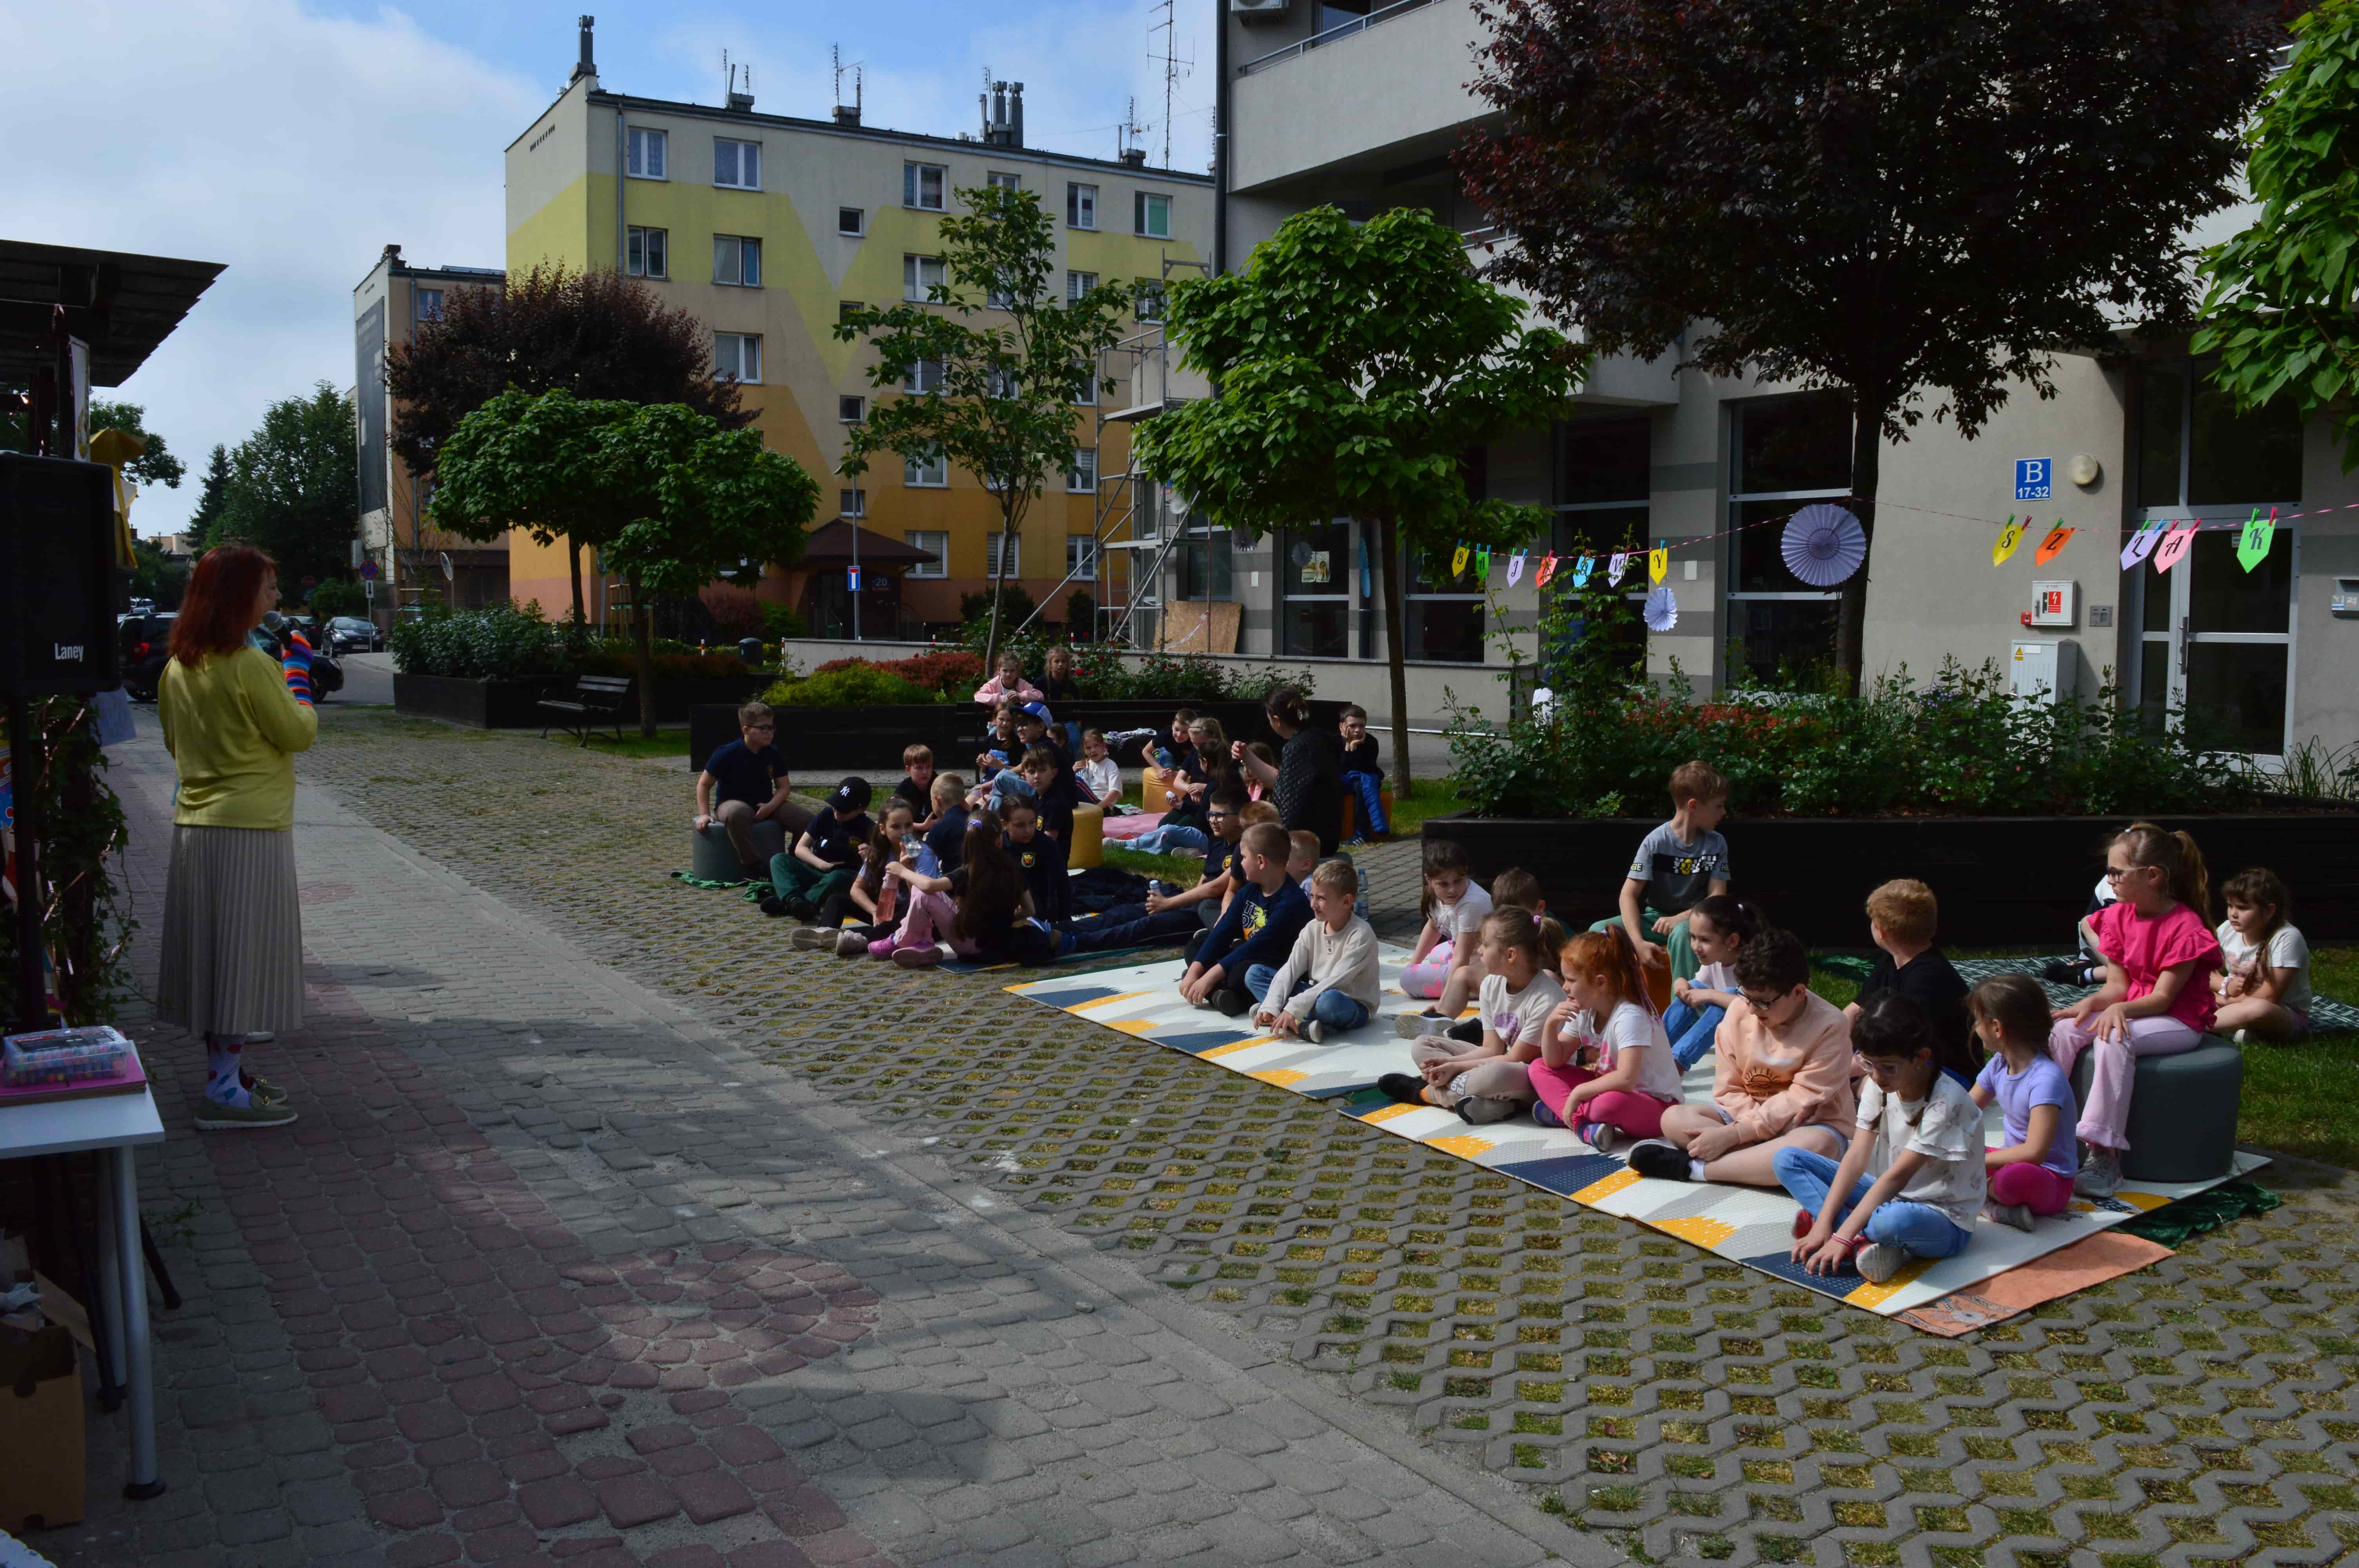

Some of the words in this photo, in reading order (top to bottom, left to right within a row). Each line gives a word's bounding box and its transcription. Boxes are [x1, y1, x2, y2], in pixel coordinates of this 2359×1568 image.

[2024, 461, 2043, 483] B
[2018, 486, 2049, 498] 17-32
[55, 643, 84, 662] Laney
